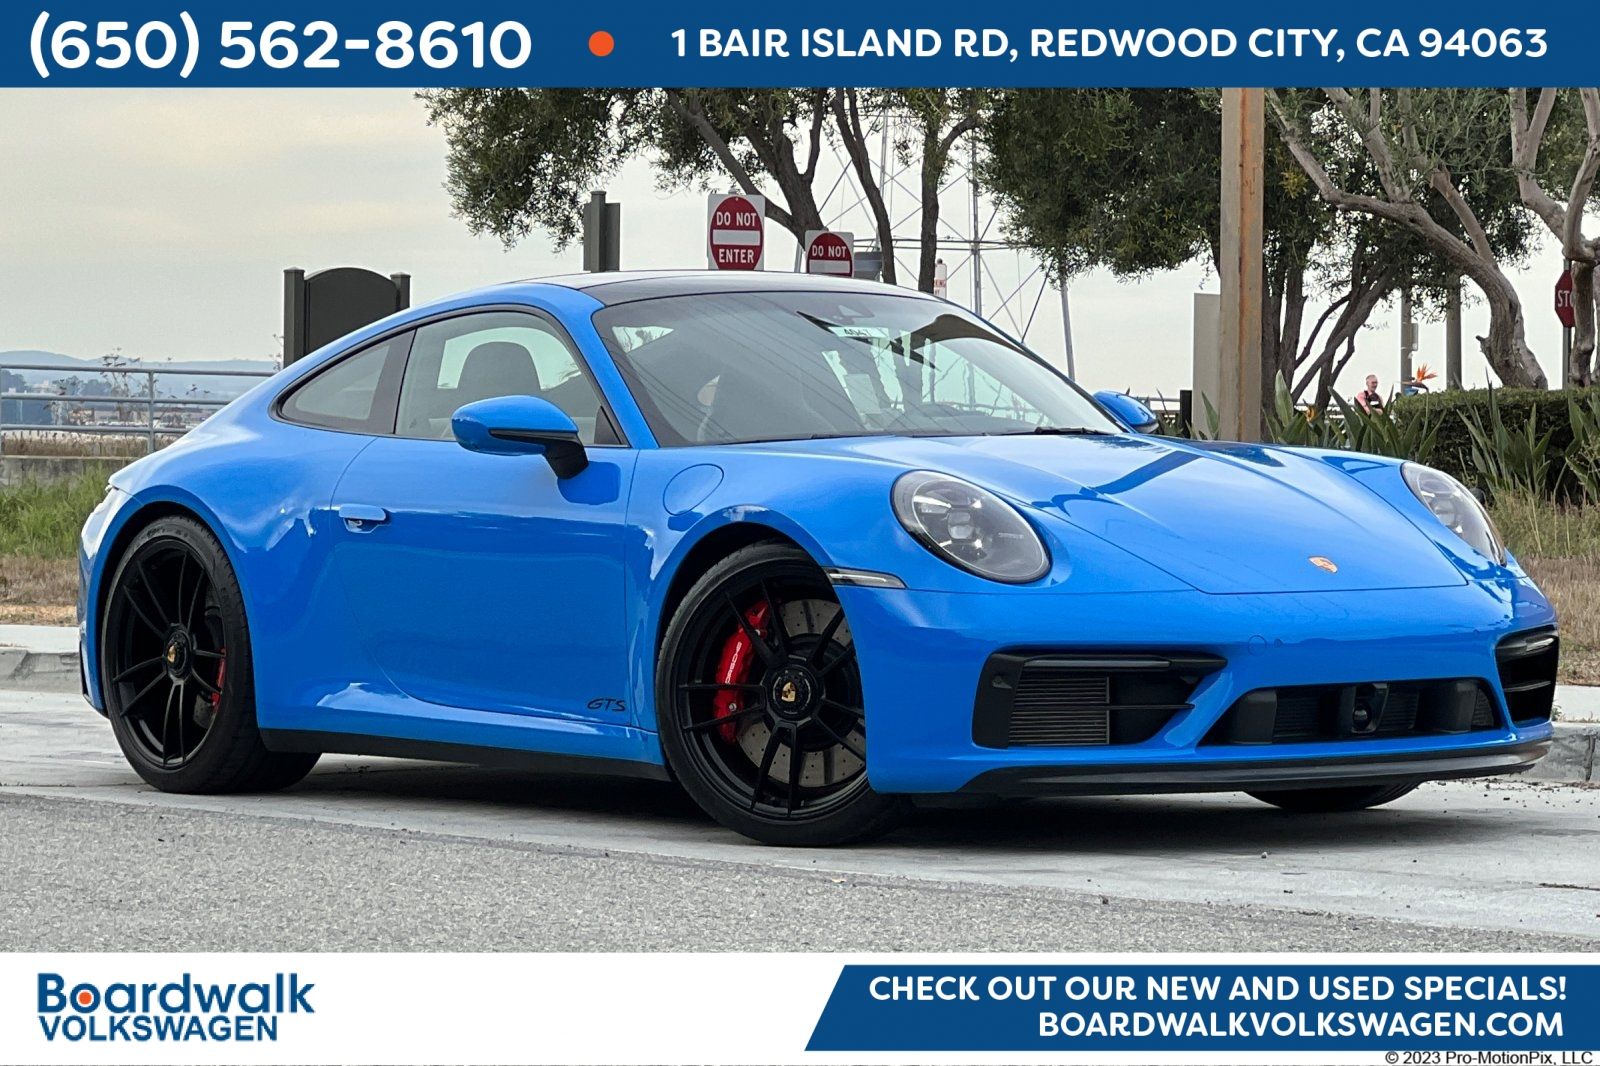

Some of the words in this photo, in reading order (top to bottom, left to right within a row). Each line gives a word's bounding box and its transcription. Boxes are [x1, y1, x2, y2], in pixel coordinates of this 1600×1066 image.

[716, 211, 731, 226] DO
[736, 211, 757, 227] NOT
[718, 248, 755, 264] ENTER
[811, 244, 824, 257] DO
[828, 245, 847, 258] NOT
[1557, 290, 1574, 307] ST
[724, 641, 743, 685] ORSCHE
[587, 698, 626, 712] GTS
